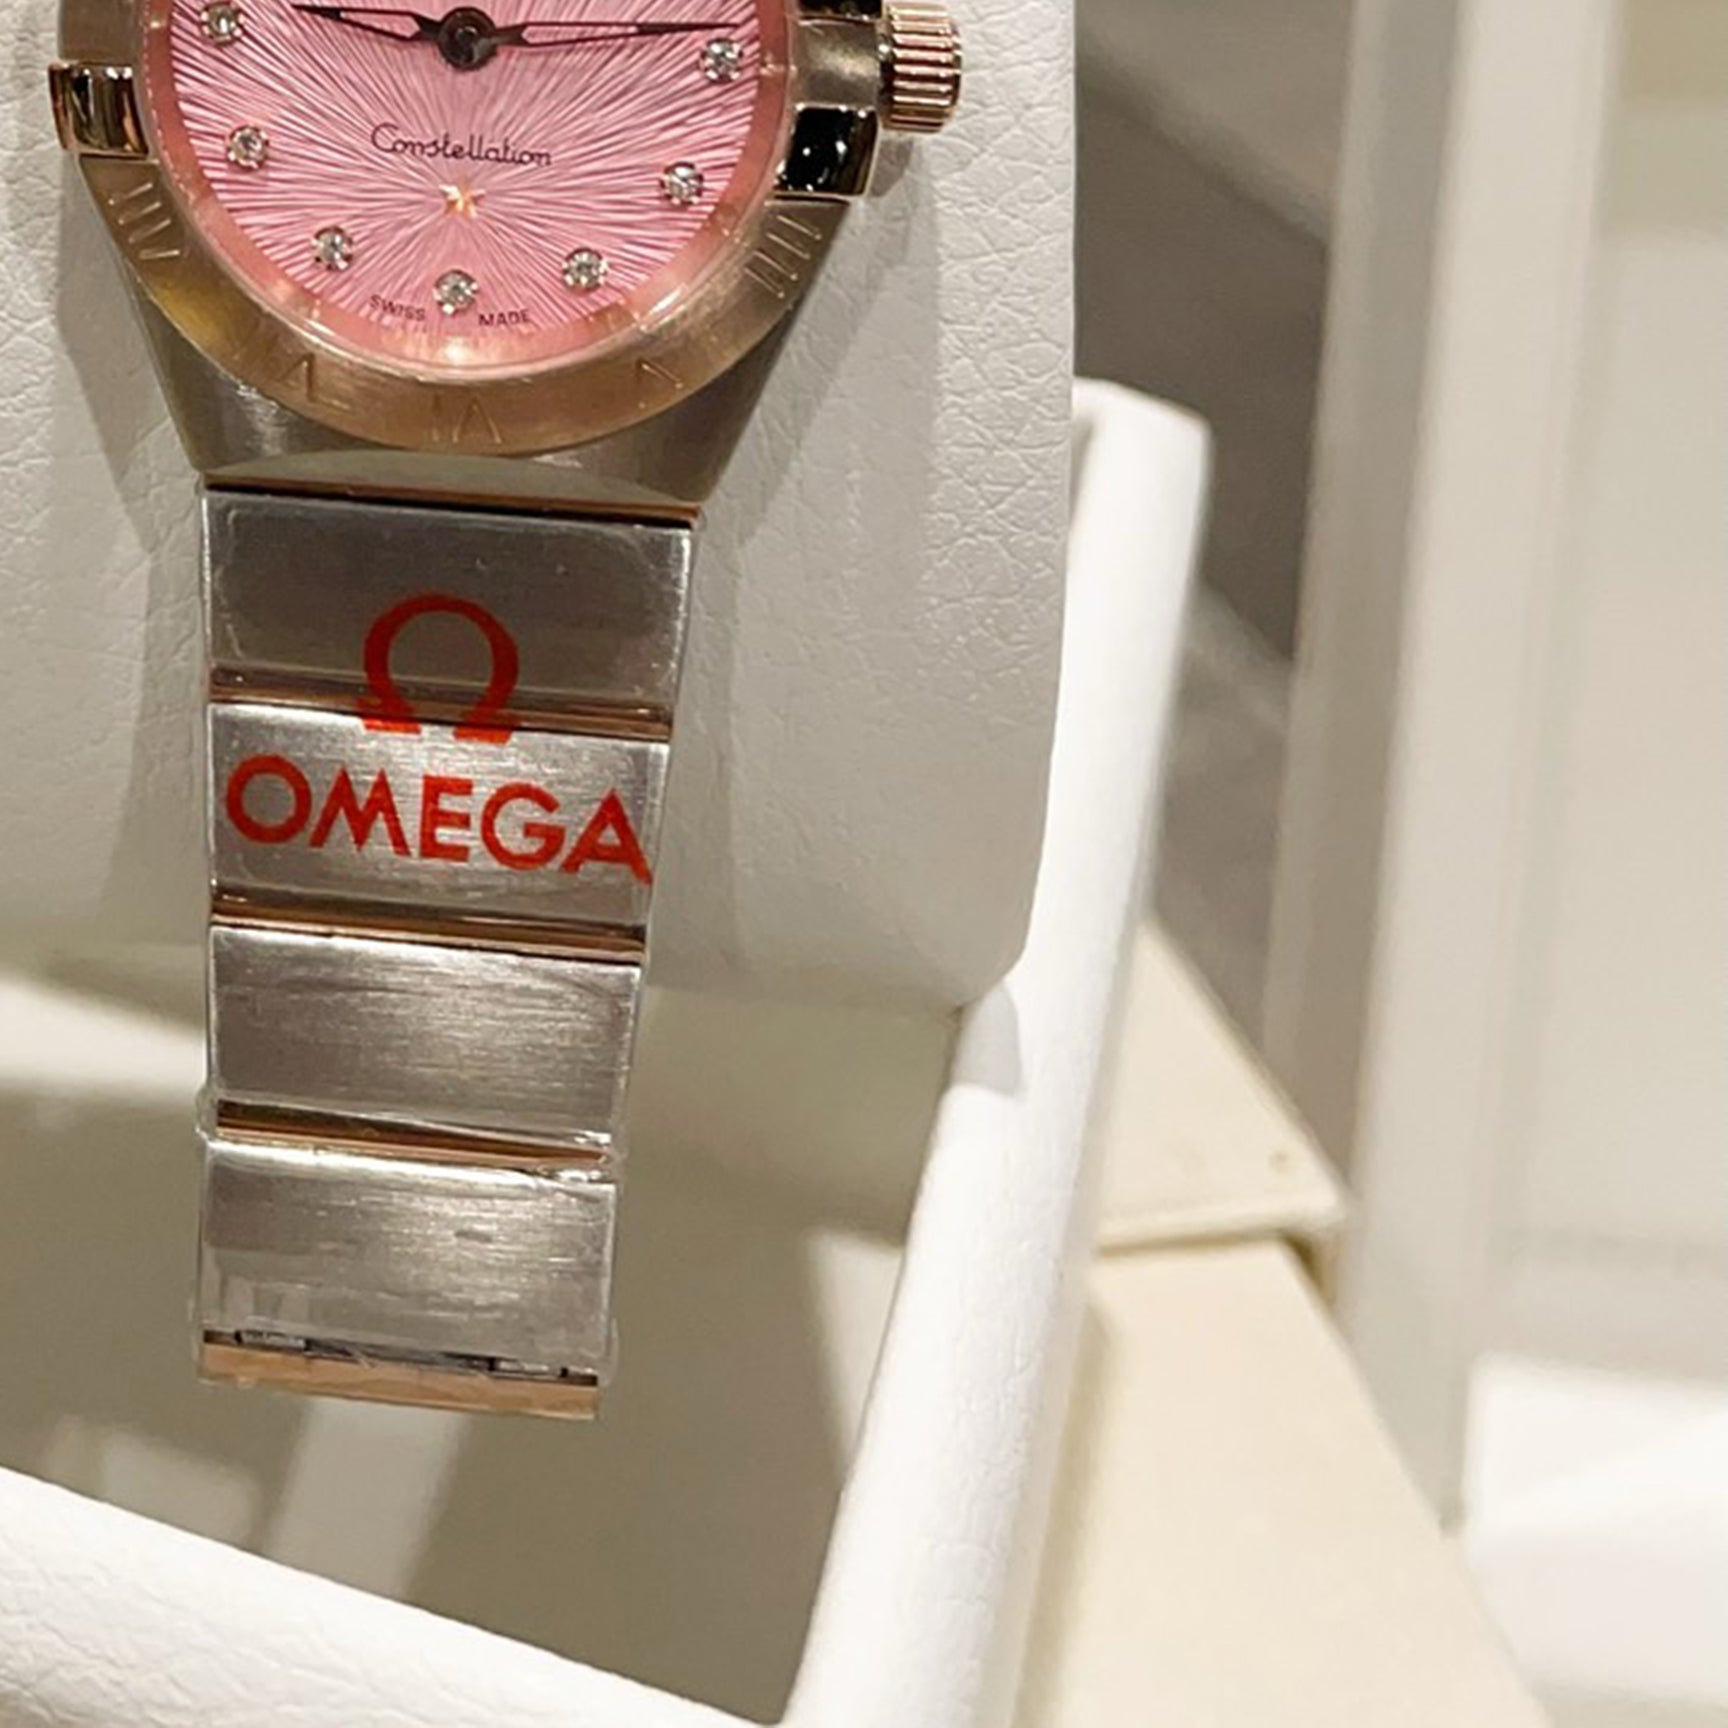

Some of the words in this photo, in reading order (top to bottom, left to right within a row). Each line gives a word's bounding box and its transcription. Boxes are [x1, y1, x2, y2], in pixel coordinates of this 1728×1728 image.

[371, 122, 552, 167] Constellation
[369, 294, 426, 322] SWISS
[478, 309, 531, 327] MADE
[225, 754, 654, 885] OMEGA
